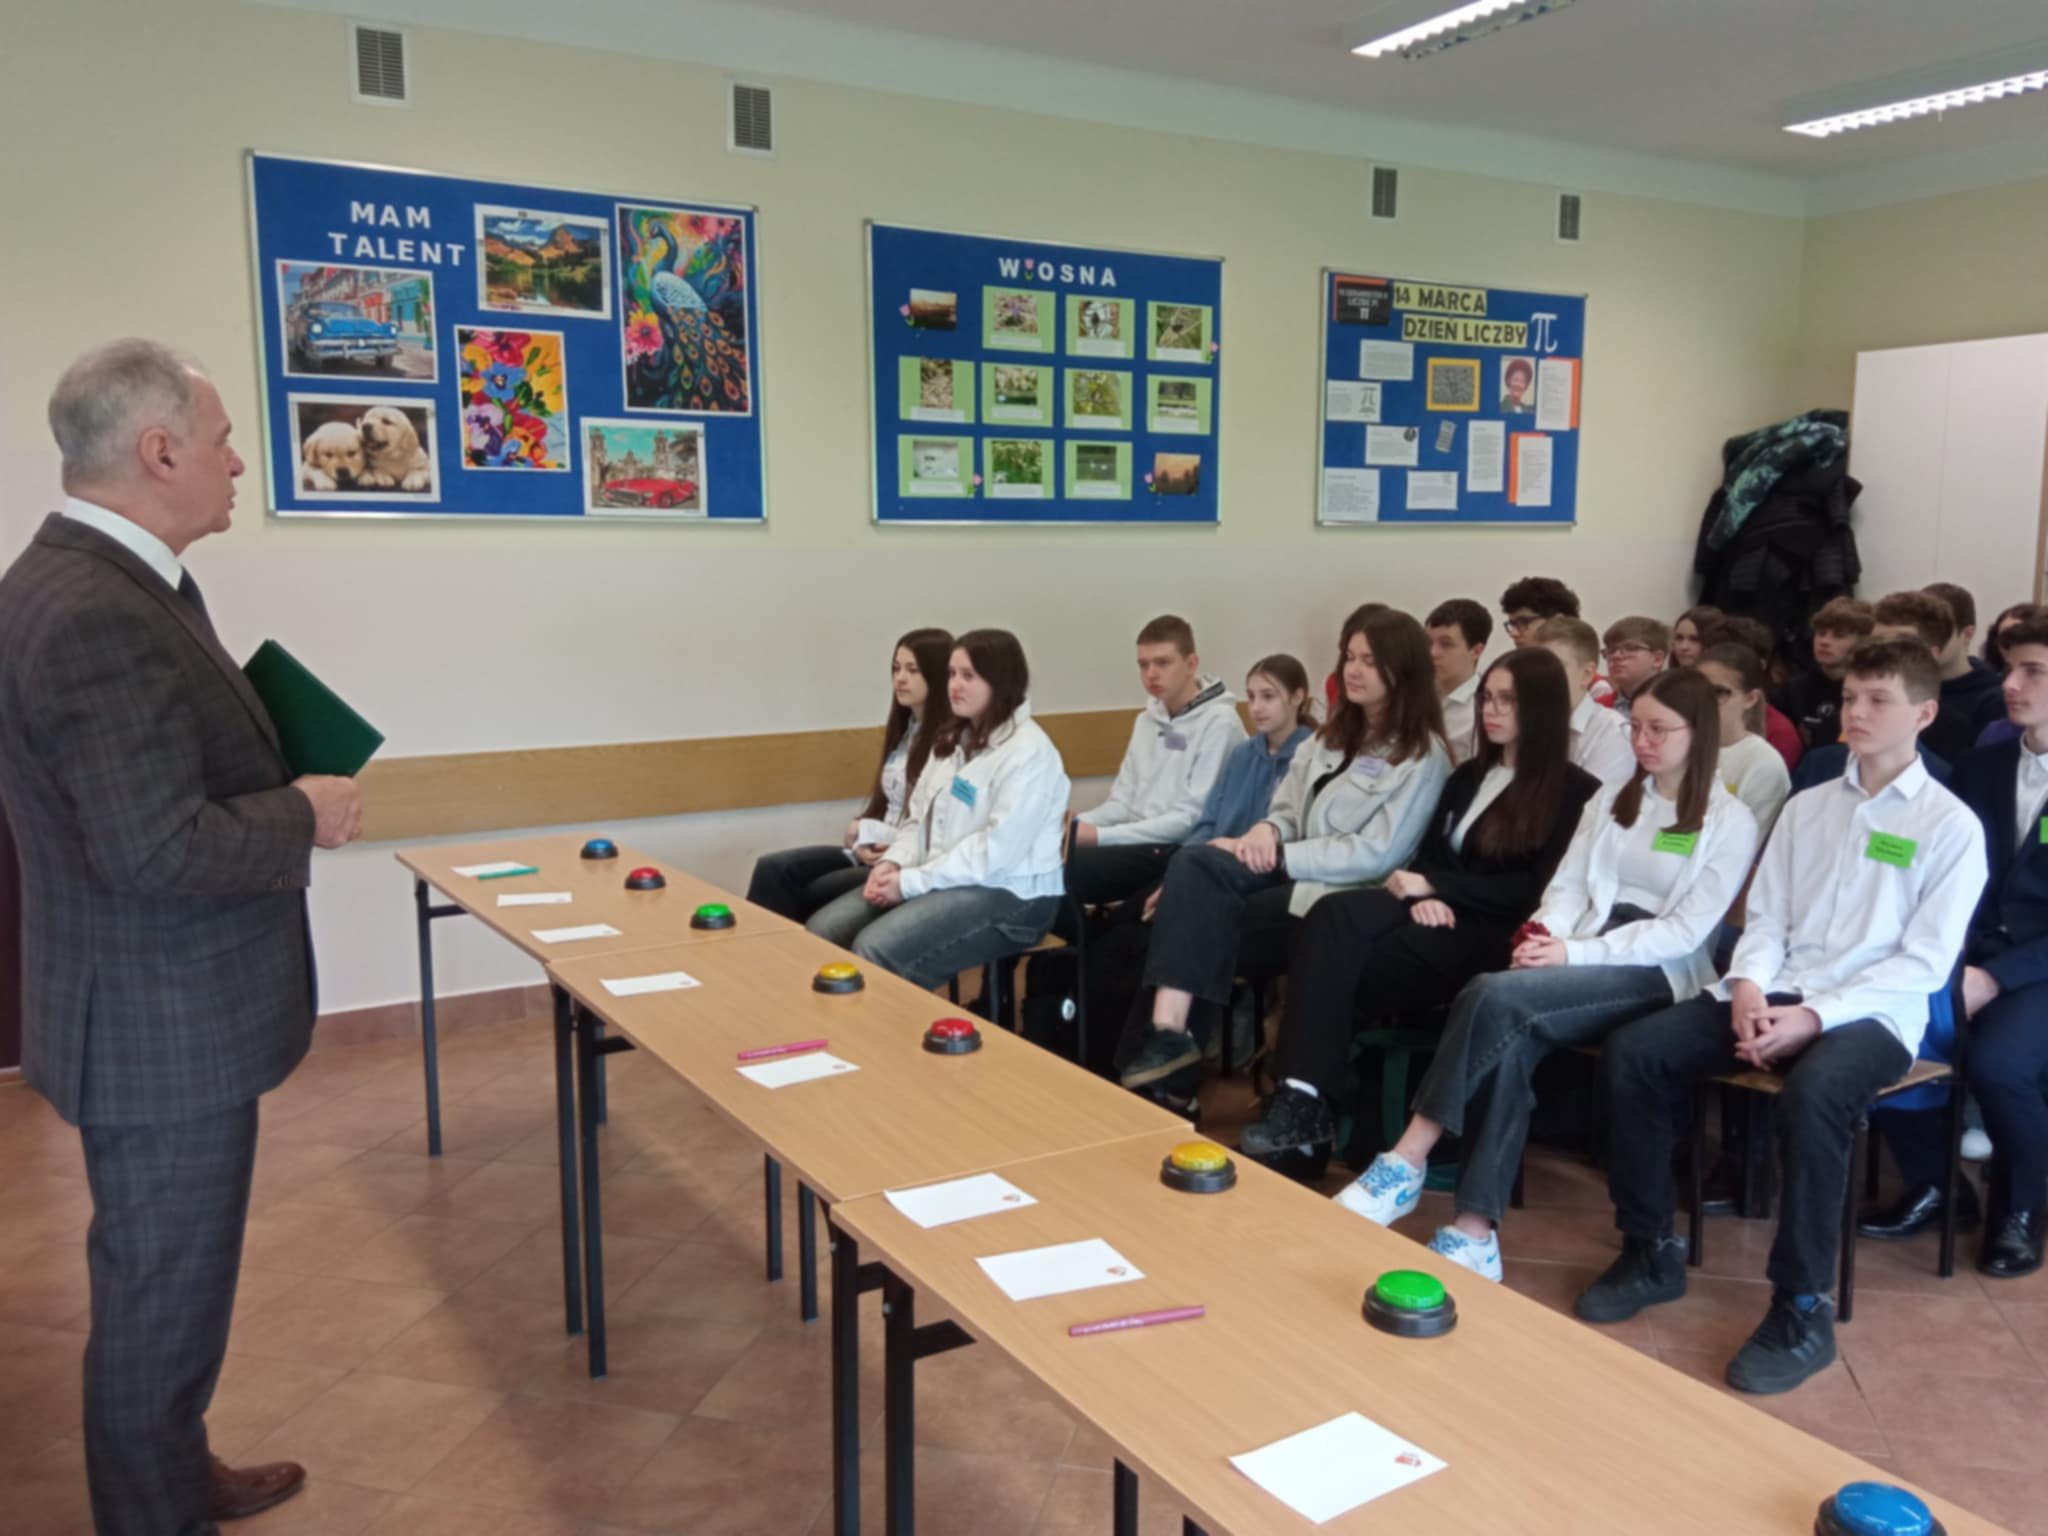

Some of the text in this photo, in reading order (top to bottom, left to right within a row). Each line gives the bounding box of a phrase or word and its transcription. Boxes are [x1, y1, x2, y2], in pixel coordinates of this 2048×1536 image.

[350, 200, 432, 229] MAM
[327, 231, 466, 267] TALENT
[1394, 286, 1411, 305] 14
[1417, 288, 1486, 314] MARCA
[1463, 323, 1526, 345] LICZBY
